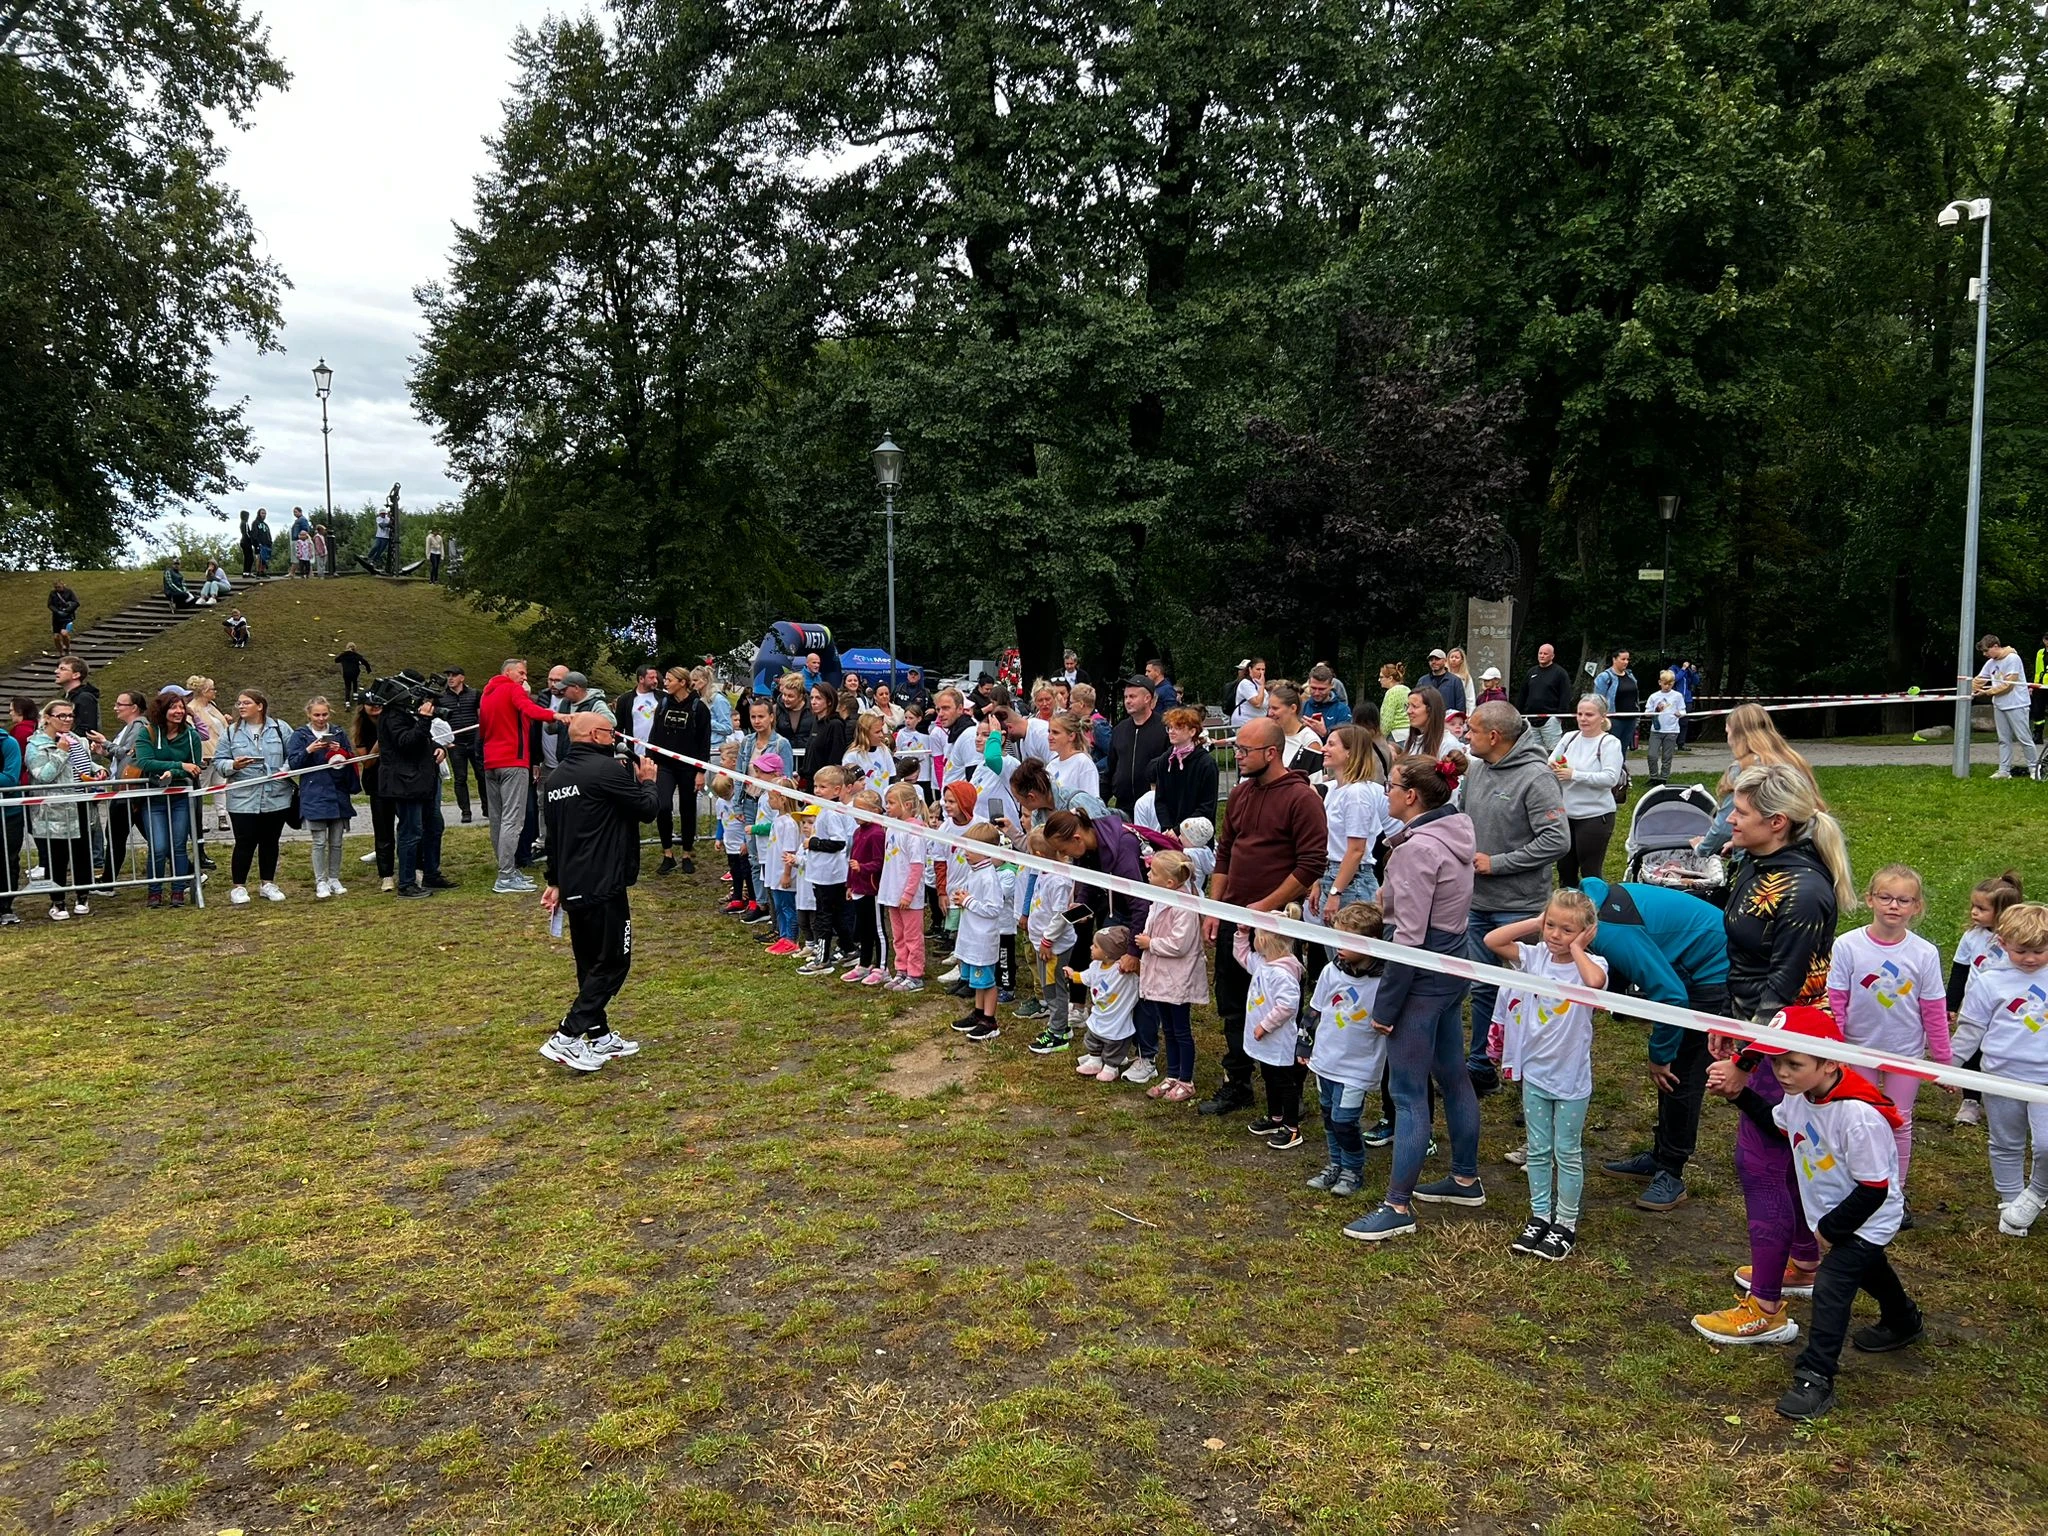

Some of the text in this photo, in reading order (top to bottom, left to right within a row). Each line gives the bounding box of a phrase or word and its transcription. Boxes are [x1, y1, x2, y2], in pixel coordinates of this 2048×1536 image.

[805, 631, 825, 649] META
[548, 784, 580, 802] POLSKA
[623, 919, 631, 955] POLSKA
[1736, 1317, 1769, 1336] HOKA
